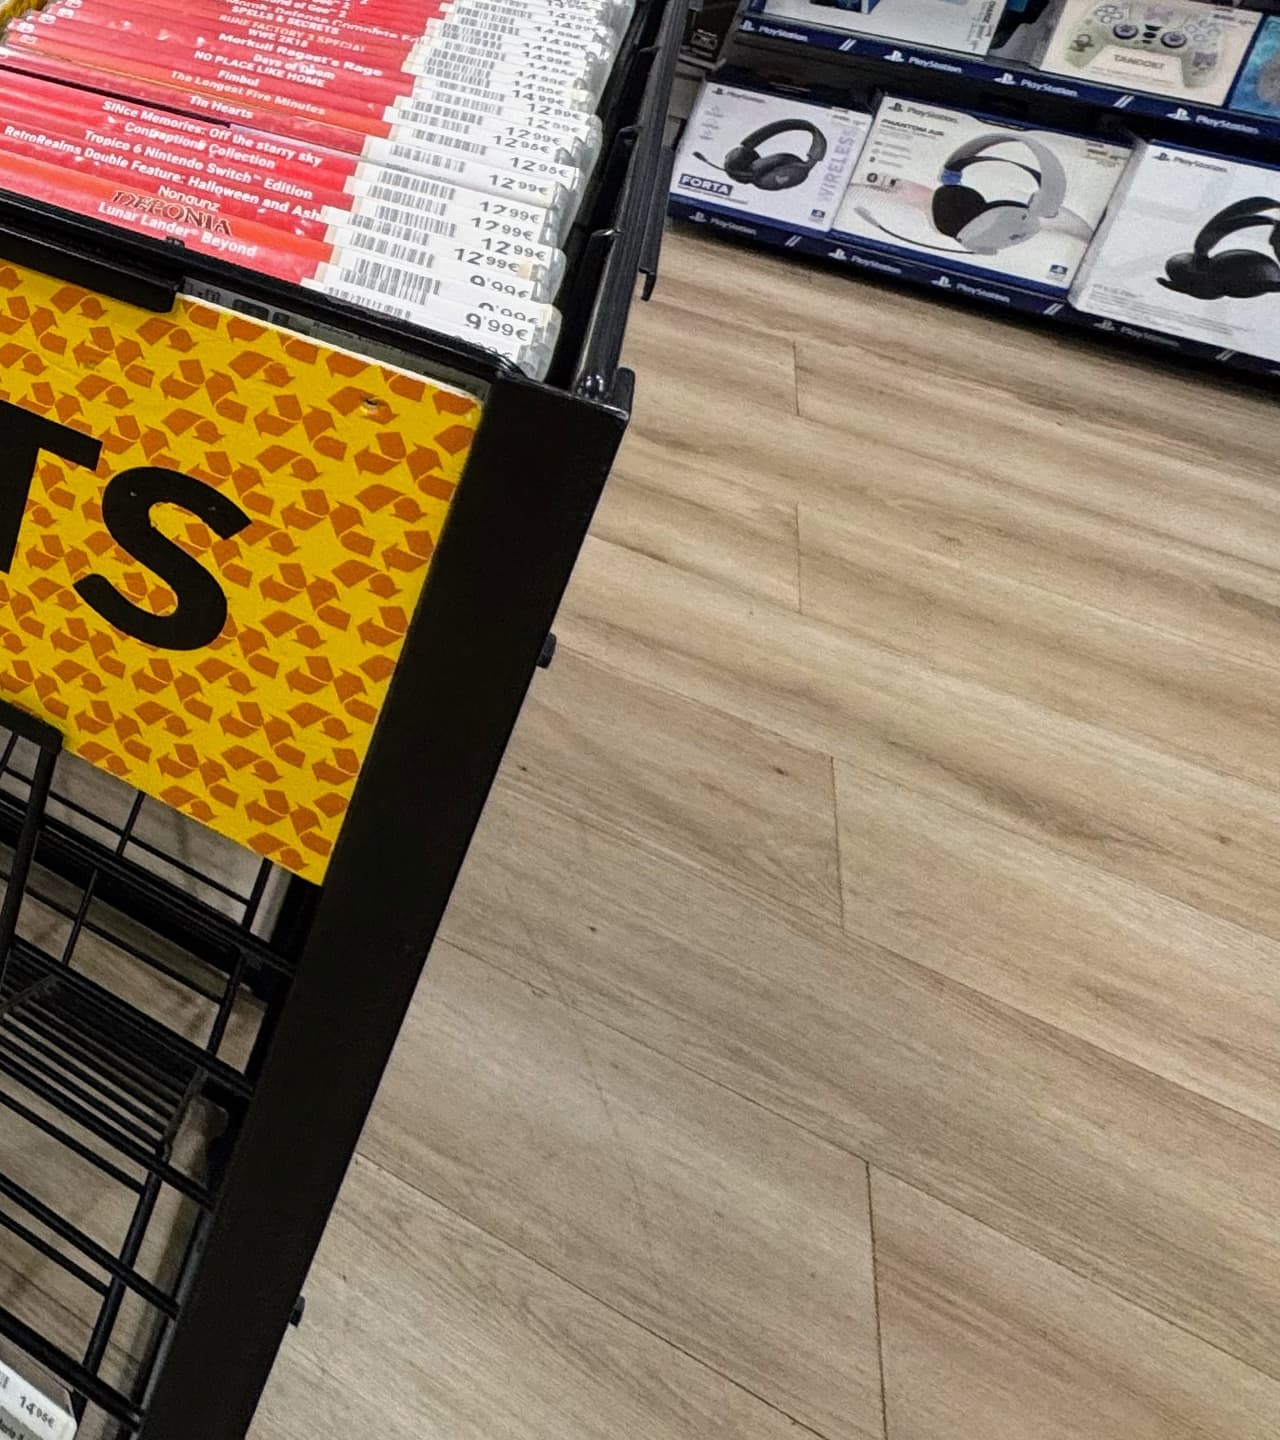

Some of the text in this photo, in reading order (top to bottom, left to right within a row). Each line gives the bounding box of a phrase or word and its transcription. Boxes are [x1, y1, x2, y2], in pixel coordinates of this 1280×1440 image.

[194, 50, 326, 88] NO PLACE LIKE HOME
[218, 70, 260, 88] Fimbul
[171, 70, 327, 116] The Longest Five Minutes
[211, 100, 254, 120] Hearts
[101, 100, 324, 168] SINce Memories: Off the starry sky
[208, 144, 277, 170] Collection
[84, 130, 132, 153] Tropico
[144, 146, 205, 171] Nintendo
[205, 161, 253, 185] Switch
[263, 177, 315, 201] Edition
[84, 147, 128, 169] Double
[130, 160, 187, 185] Feature:
[187, 172, 260, 205] Halloween
[261, 197, 289, 214] and
[291, 204, 322, 221] Ash
[681, 175, 730, 195] FORTA
[98, 201, 260, 258] Lunar Lander Beyond
[110, 190, 233, 237] DEPONIA
